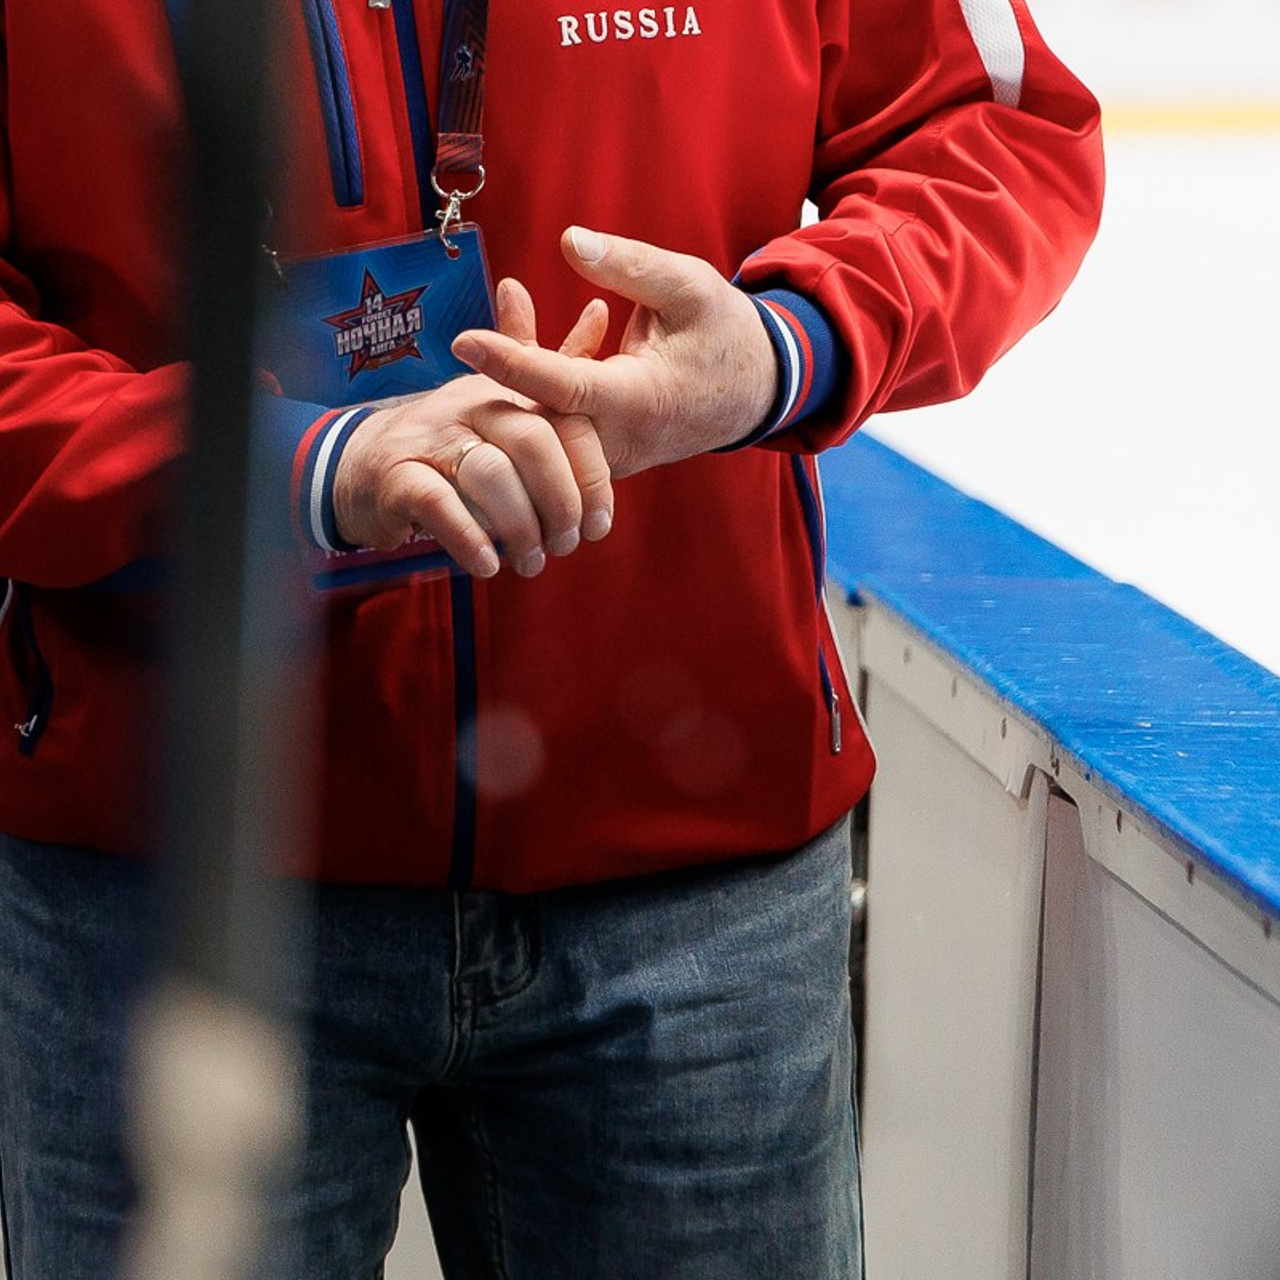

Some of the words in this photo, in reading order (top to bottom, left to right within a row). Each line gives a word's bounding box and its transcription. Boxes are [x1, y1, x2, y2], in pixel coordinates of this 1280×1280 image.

[557, 6, 701, 46] RUSSIA
[365, 293, 383, 314] 14
[335, 307, 421, 355] НОЧНАЯ
